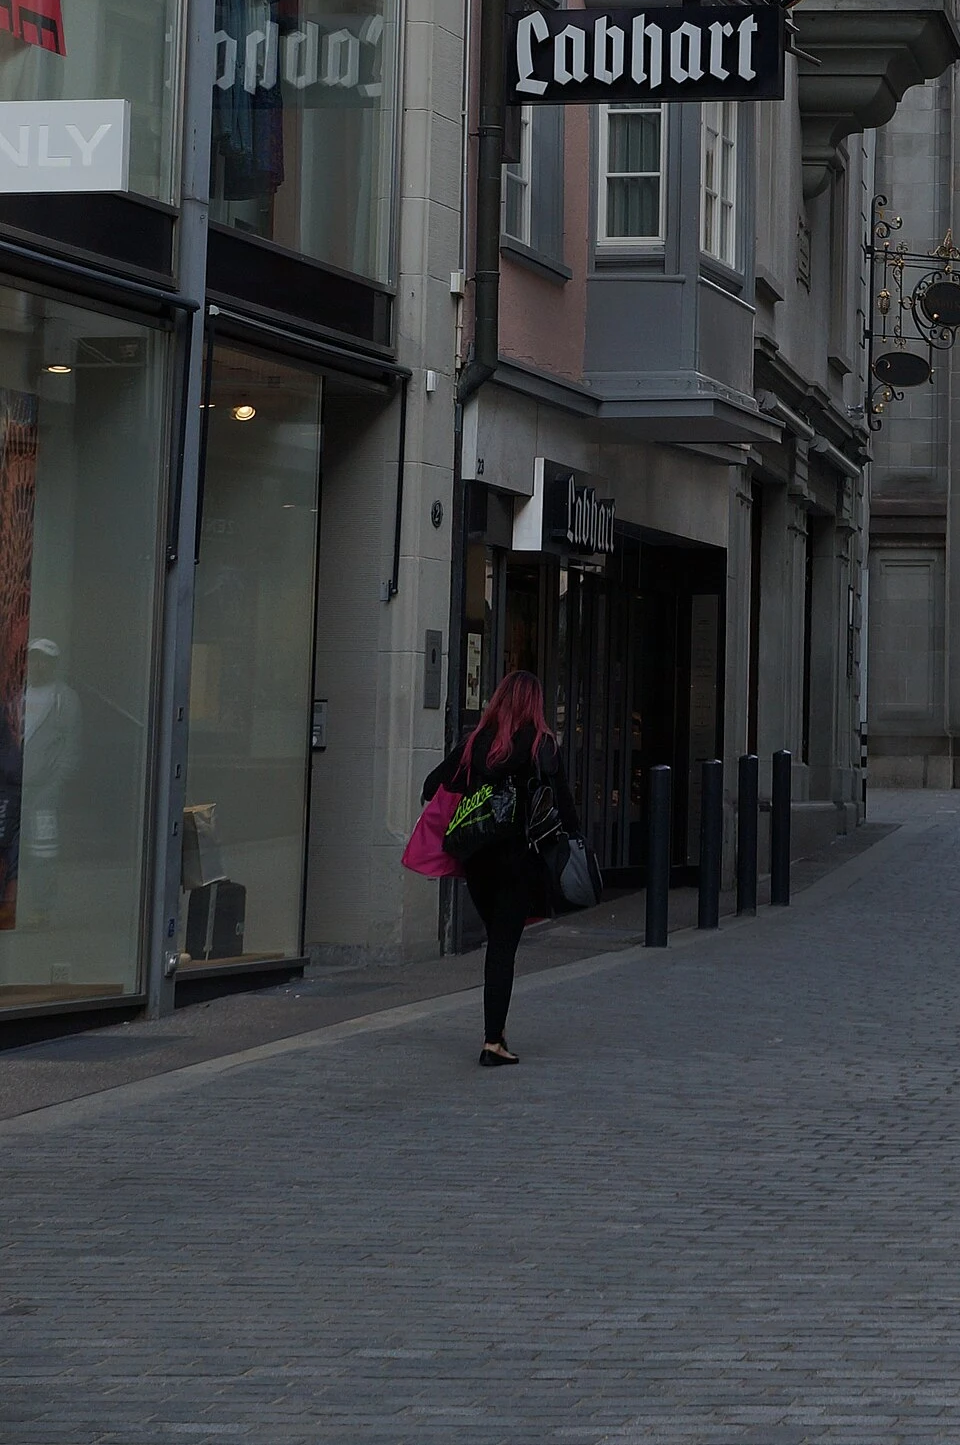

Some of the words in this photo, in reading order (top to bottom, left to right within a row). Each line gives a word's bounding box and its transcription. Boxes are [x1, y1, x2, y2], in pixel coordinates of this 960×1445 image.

[516, 10, 758, 96] Labhart
[477, 458, 485, 476] 23
[566, 473, 616, 554] Labhart
